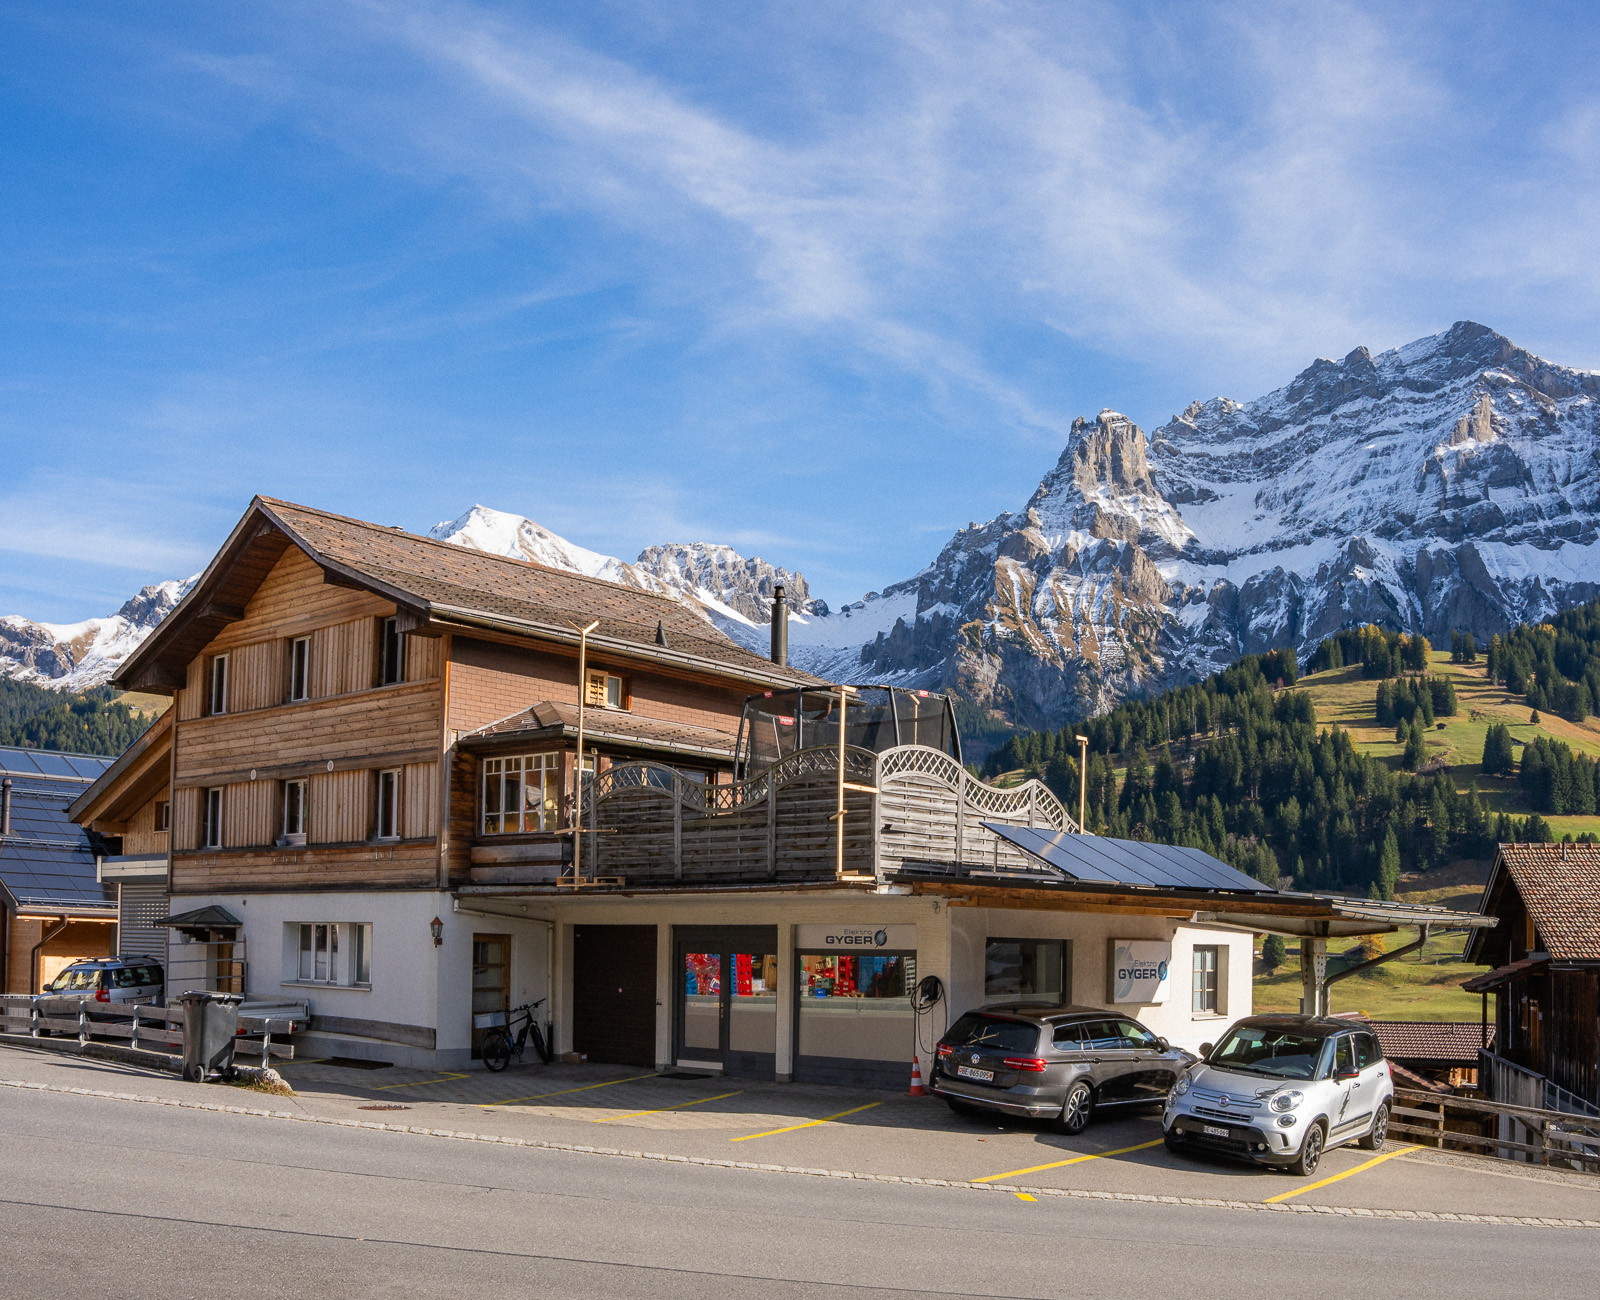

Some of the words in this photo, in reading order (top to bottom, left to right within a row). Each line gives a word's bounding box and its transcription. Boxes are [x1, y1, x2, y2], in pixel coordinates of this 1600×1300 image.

[825, 935, 873, 945] GYGER
[1134, 959, 1157, 967] Elektro
[1118, 968, 1157, 980] GYGER
